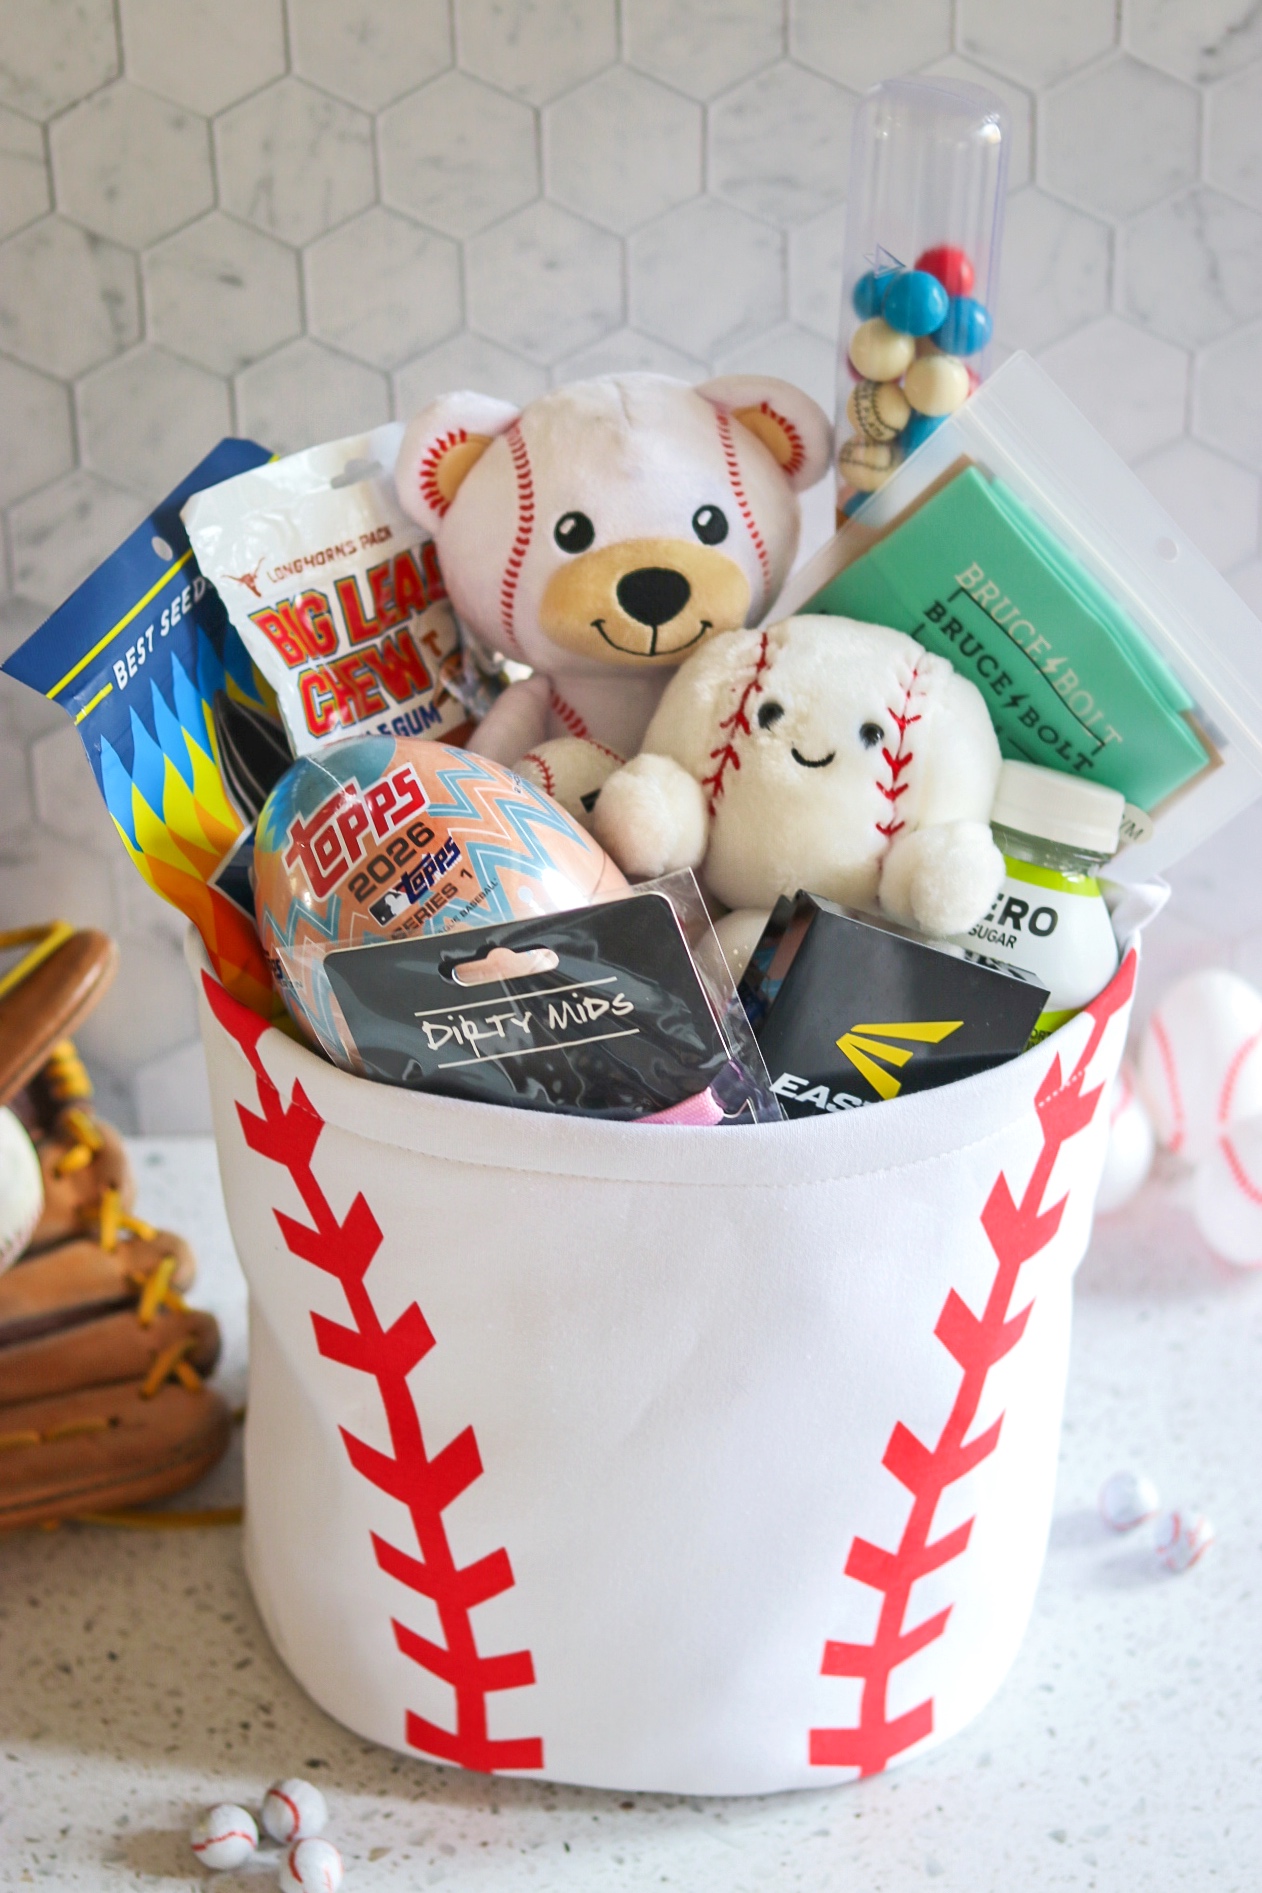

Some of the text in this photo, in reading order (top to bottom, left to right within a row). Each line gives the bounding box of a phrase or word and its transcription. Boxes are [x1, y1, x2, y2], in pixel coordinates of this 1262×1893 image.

[267, 525, 393, 583] LONGHORNS PACK
[112, 575, 212, 691] BEST SEED
[251, 588, 340, 669] BIG
[954, 562, 1123, 748] BRUCE BOLT
[298, 626, 433, 739] CHEW
[923, 600, 1095, 773] BRUCE BOLT
[348, 821, 435, 904] 2026
[391, 868, 473, 940] SERIES 1
[768, 1072, 874, 1113] EAS
